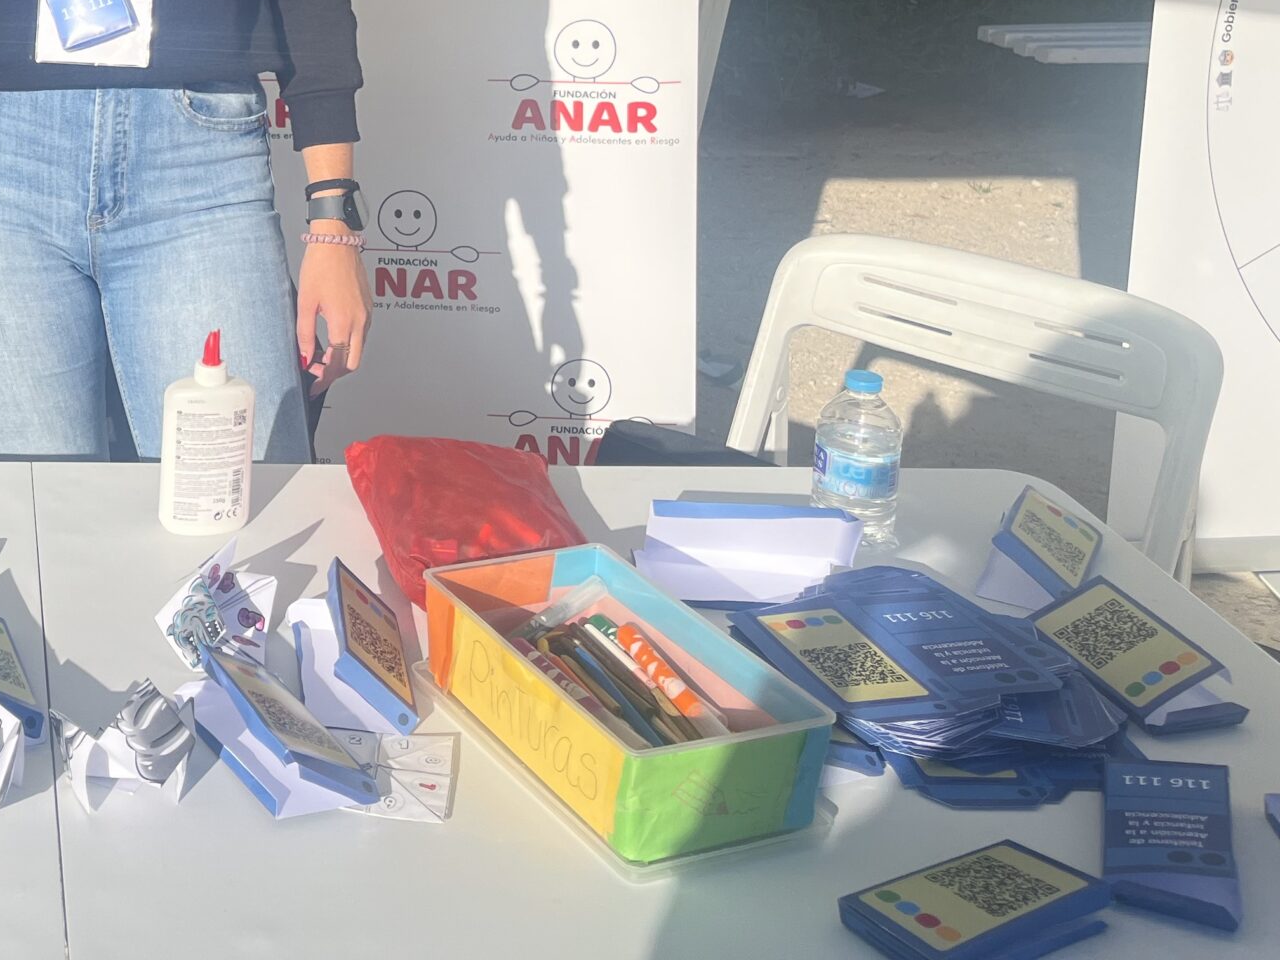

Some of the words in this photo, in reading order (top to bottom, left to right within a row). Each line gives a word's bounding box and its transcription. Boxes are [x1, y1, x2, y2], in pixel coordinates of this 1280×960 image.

[553, 90, 617, 99] FUNDACIÓN
[511, 98, 657, 133] ANAR
[488, 133, 518, 143] Ayuda
[530, 133, 558, 143] Niños
[569, 135, 632, 145] Adolescentes
[650, 136, 680, 146] Riesgo
[378, 257, 438, 267] FUNDACIÓN
[375, 267, 478, 301] NAR
[394, 301, 453, 312] Adolescentes
[470, 304, 501, 314] Riesgo
[550, 425, 605, 435] FUNDACIÓ
[883, 611, 918, 623] 111
[920, 609, 953, 619] 116
[922, 640, 984, 650] Adolescencia
[952, 647, 991, 656] Infancia
[959, 655, 1002, 663] Atención
[966, 662, 1011, 671] Teléfono
[470, 639, 598, 802] Pinturas
[1122, 775, 1161, 786] 111
[1170, 778, 1211, 790] 116
[1124, 811, 1208, 821] Adolescencia
[1153, 821, 1204, 830] Infancia
[1150, 829, 1208, 839] Atención
[1147, 839, 1204, 848] Teléfono
